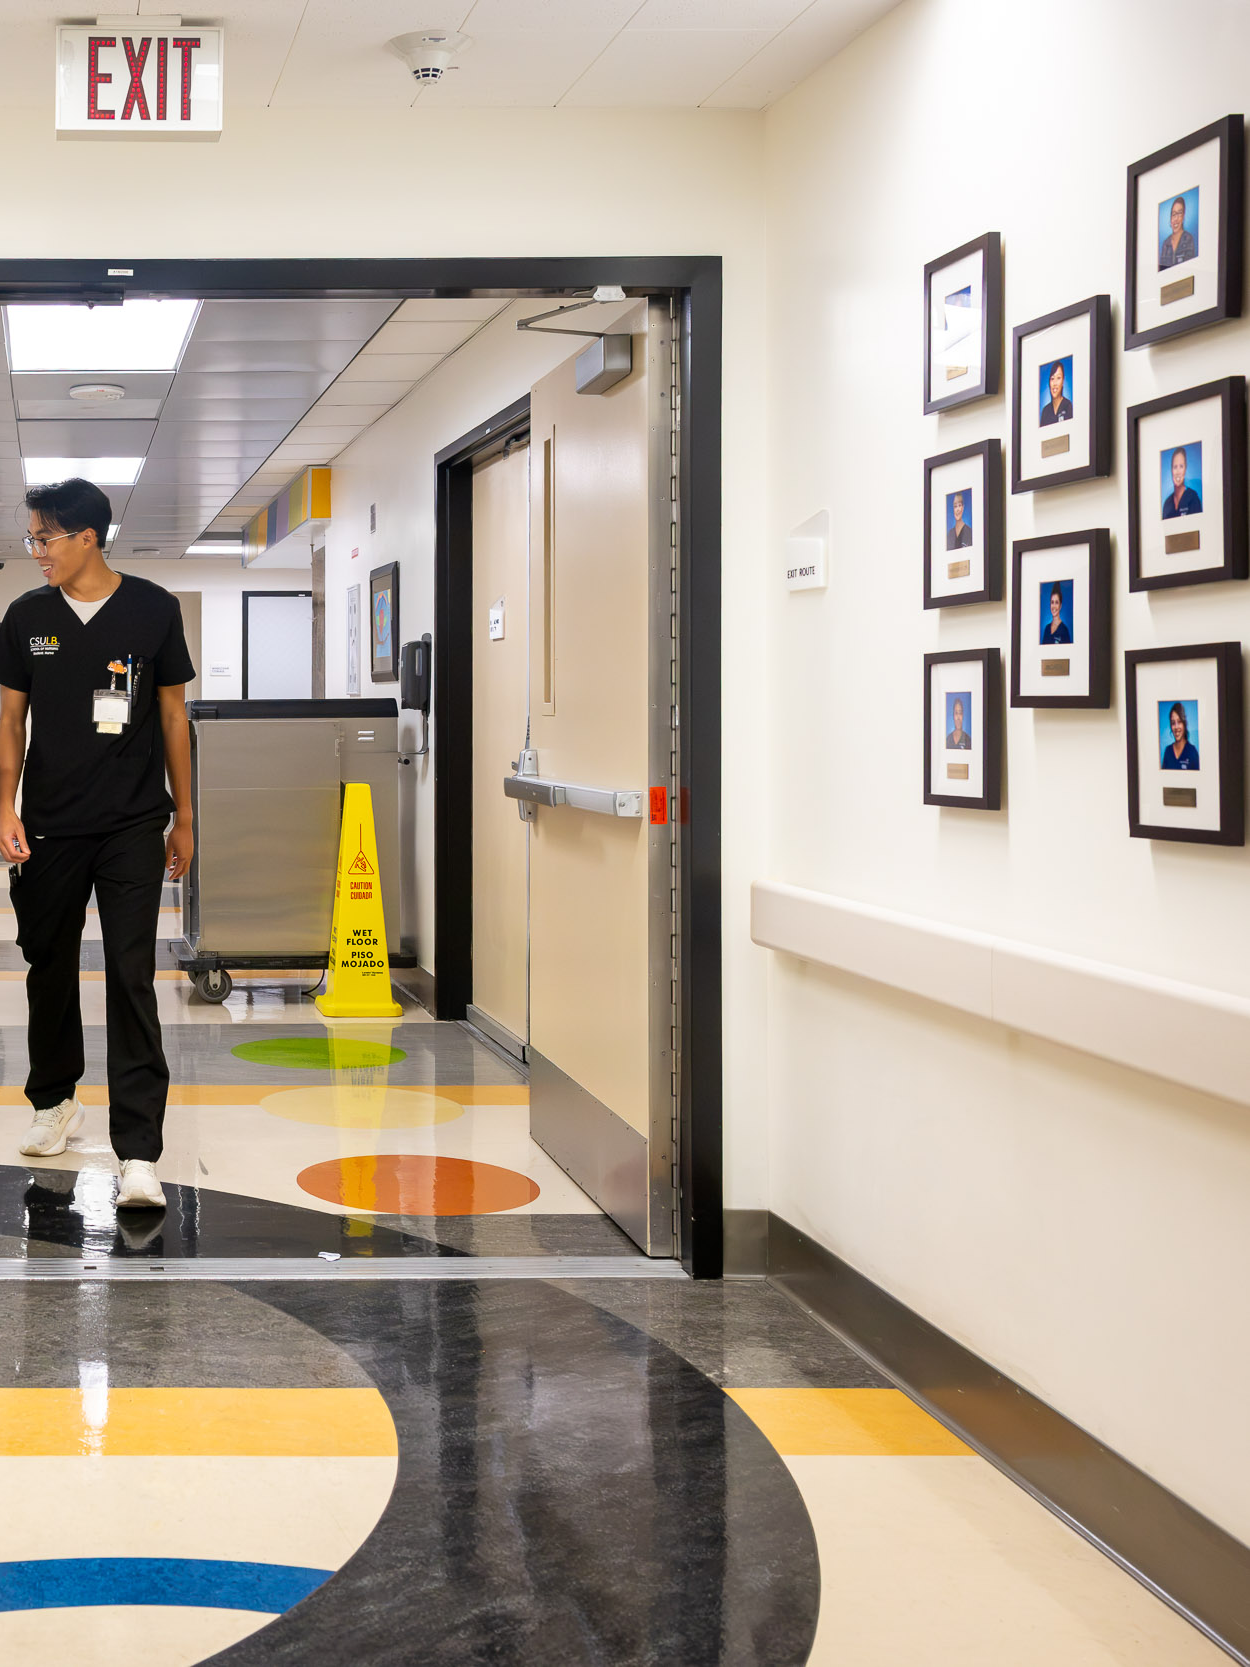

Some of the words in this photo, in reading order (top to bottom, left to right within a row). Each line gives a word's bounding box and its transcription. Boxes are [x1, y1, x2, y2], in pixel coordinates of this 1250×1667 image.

[87, 36, 201, 121] EXIT
[787, 568, 798, 579] EXIT
[799, 565, 815, 577] ROUTE
[29, 636, 58, 646] CSULB
[350, 881, 373, 890] CAUTION
[350, 891, 373, 900] CUIDADO
[352, 929, 373, 937] WET
[346, 938, 379, 946] FLOOR
[351, 951, 374, 959] PISO
[341, 960, 385, 968] MOJADO
